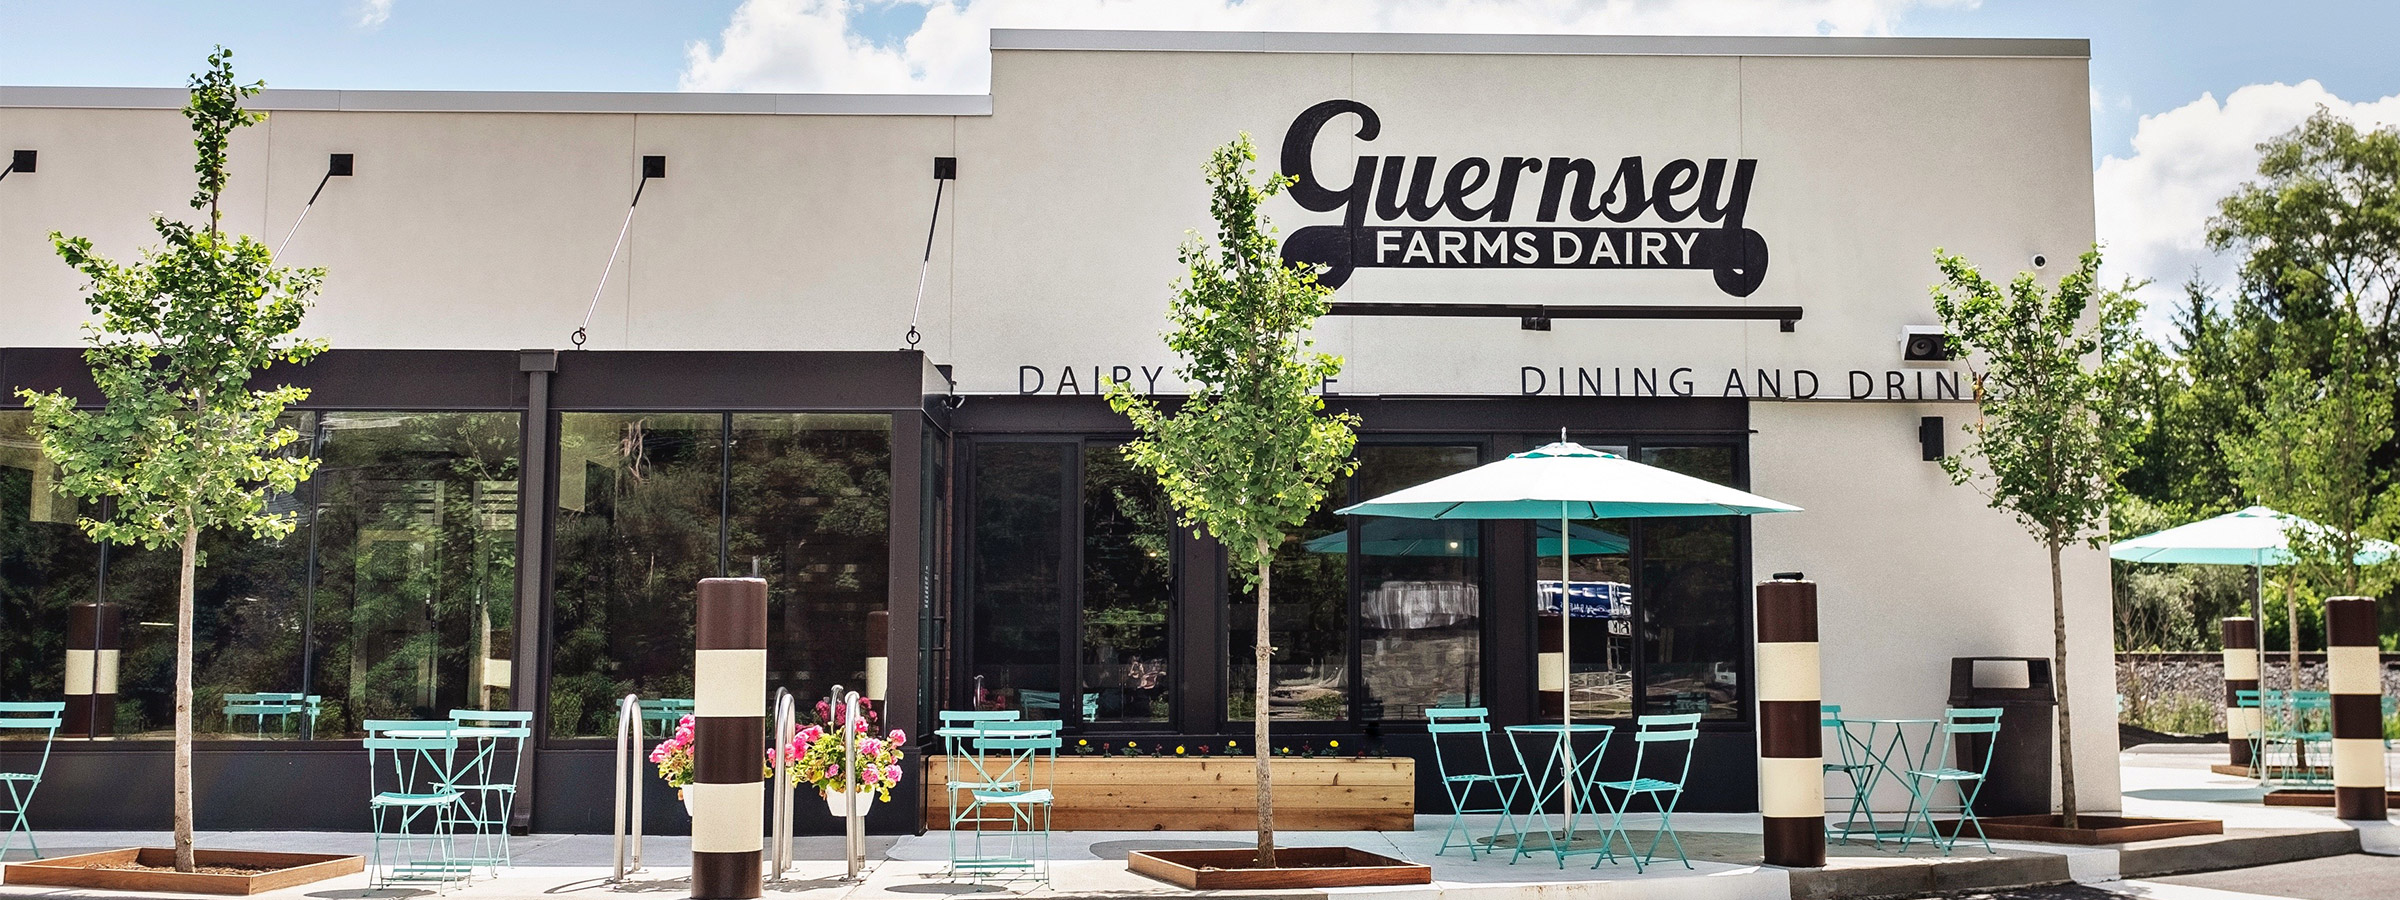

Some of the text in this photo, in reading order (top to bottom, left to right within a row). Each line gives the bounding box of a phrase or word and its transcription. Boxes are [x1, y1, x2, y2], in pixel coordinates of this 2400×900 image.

[1280, 99, 1768, 297] Guernsey
[1376, 230, 1700, 266] FARMS DAIRY
[1019, 365, 1164, 396] DAIRY
[1521, 366, 1694, 397] DINING
[1723, 368, 1819, 399] AND
